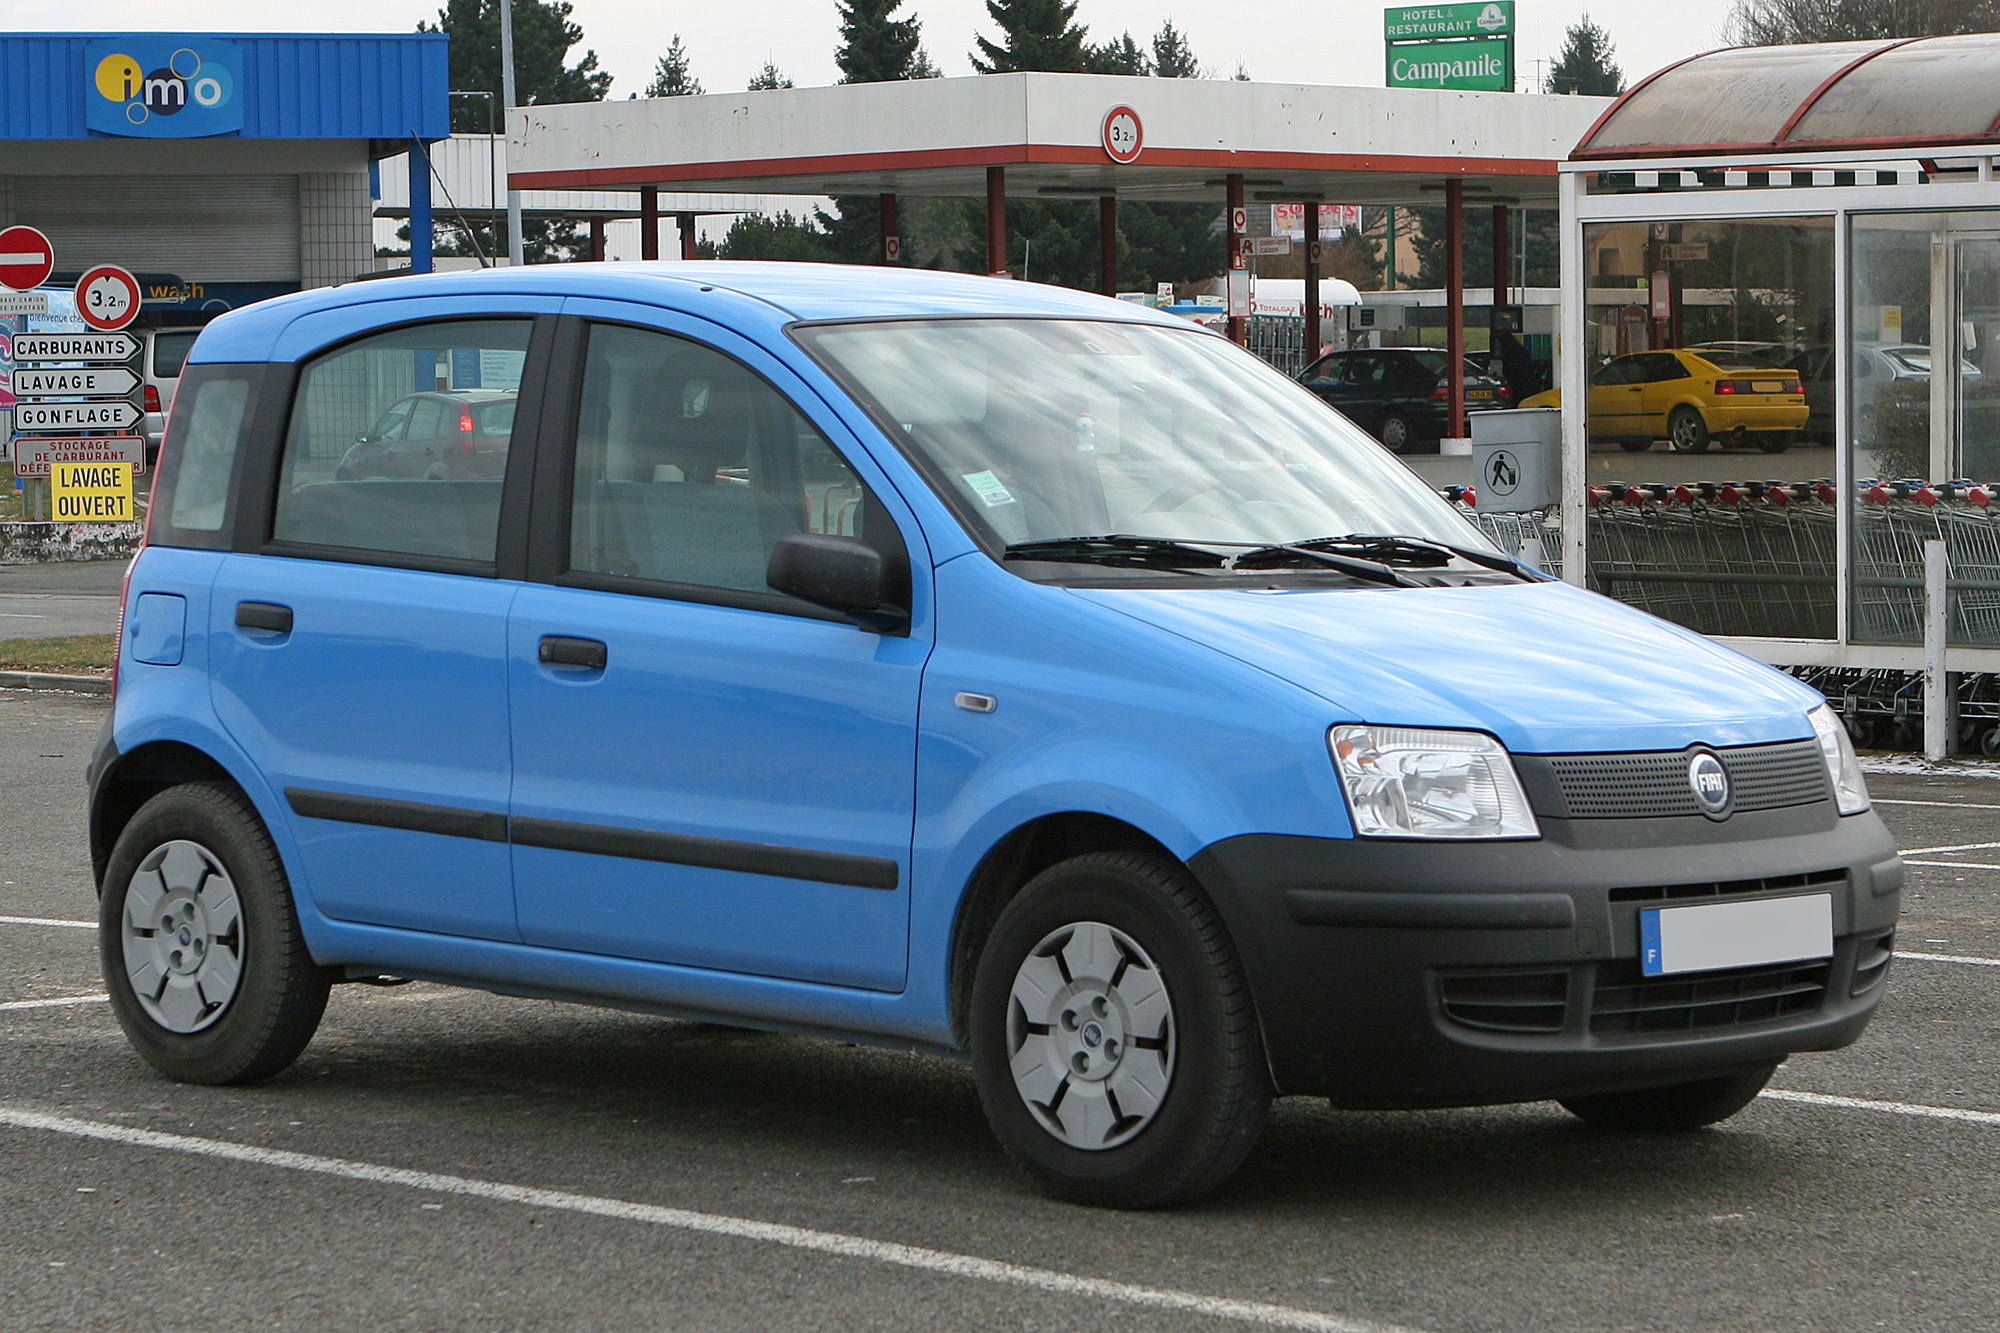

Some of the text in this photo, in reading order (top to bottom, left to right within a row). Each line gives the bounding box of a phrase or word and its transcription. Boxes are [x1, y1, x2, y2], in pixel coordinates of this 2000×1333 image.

[1402, 9, 1444, 21] HOTEL
[1388, 21, 1472, 35] RESTAURANT
[1392, 53, 1502, 85] Campanile
[123, 67, 222, 106] imo
[17, 340, 125, 355] CARBURANTS
[21, 375, 96, 390] LAVAGE
[23, 408, 123, 424] GONFLAGE
[50, 441, 110, 451] STOCKAGE
[35, 451, 125, 462] DE CARBURANT
[61, 467, 122, 488] LAVAGE
[58, 496, 126, 516] OUVERT
[1698, 772, 1723, 792] FIAT
[1647, 948, 1656, 964] F
